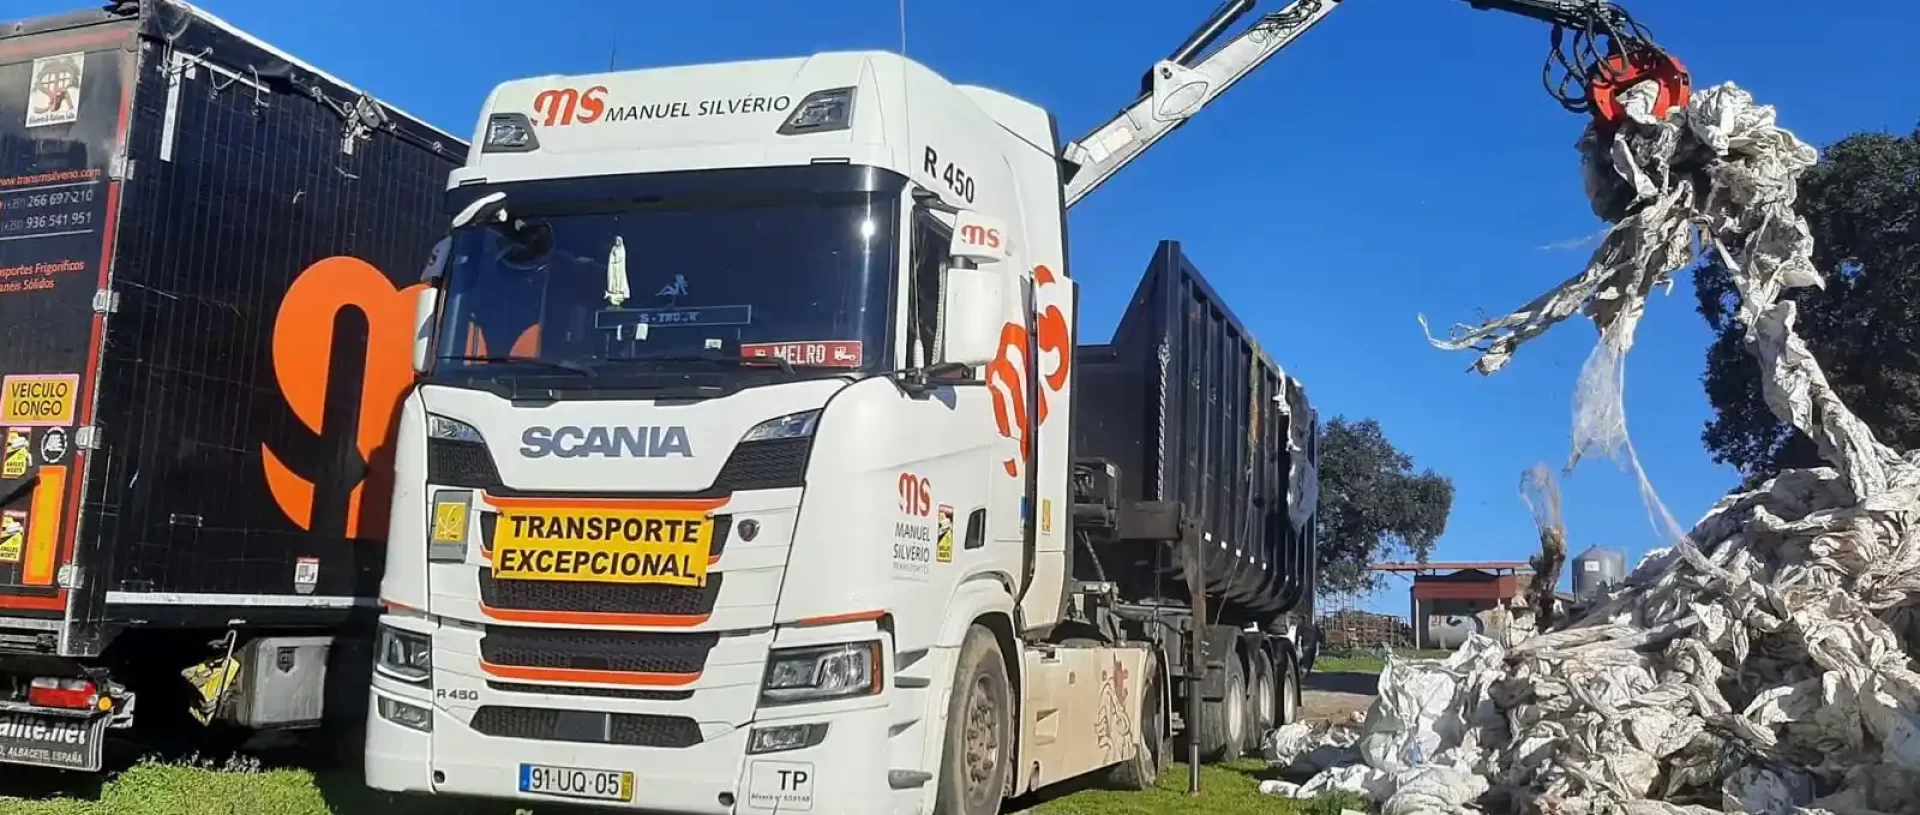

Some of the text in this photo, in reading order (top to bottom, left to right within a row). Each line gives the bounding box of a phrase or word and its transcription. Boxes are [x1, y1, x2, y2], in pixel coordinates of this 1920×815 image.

[605, 101, 690, 122] MANUEL
[699, 93, 790, 116] SILVÉRIO
[924, 145, 974, 204] R 450
[27, 194, 47, 208] 266
[49, 191, 70, 206] 697
[71, 189, 93, 203] 210
[26, 216, 46, 229] 936
[48, 213, 68, 227] 541
[71, 211, 91, 225] 951
[774, 344, 826, 366] MELRO
[12, 382, 68, 398] VEICULO
[13, 400, 62, 416] LONGO
[519, 425, 694, 458] SCANIA
[510, 515, 702, 543] TRANSPORTE
[894, 522, 931, 542] MANUEL
[500, 549, 697, 578] EXCEPCIONAL
[893, 543, 931, 563] SILVÉRIO
[777, 769, 808, 791] TP
